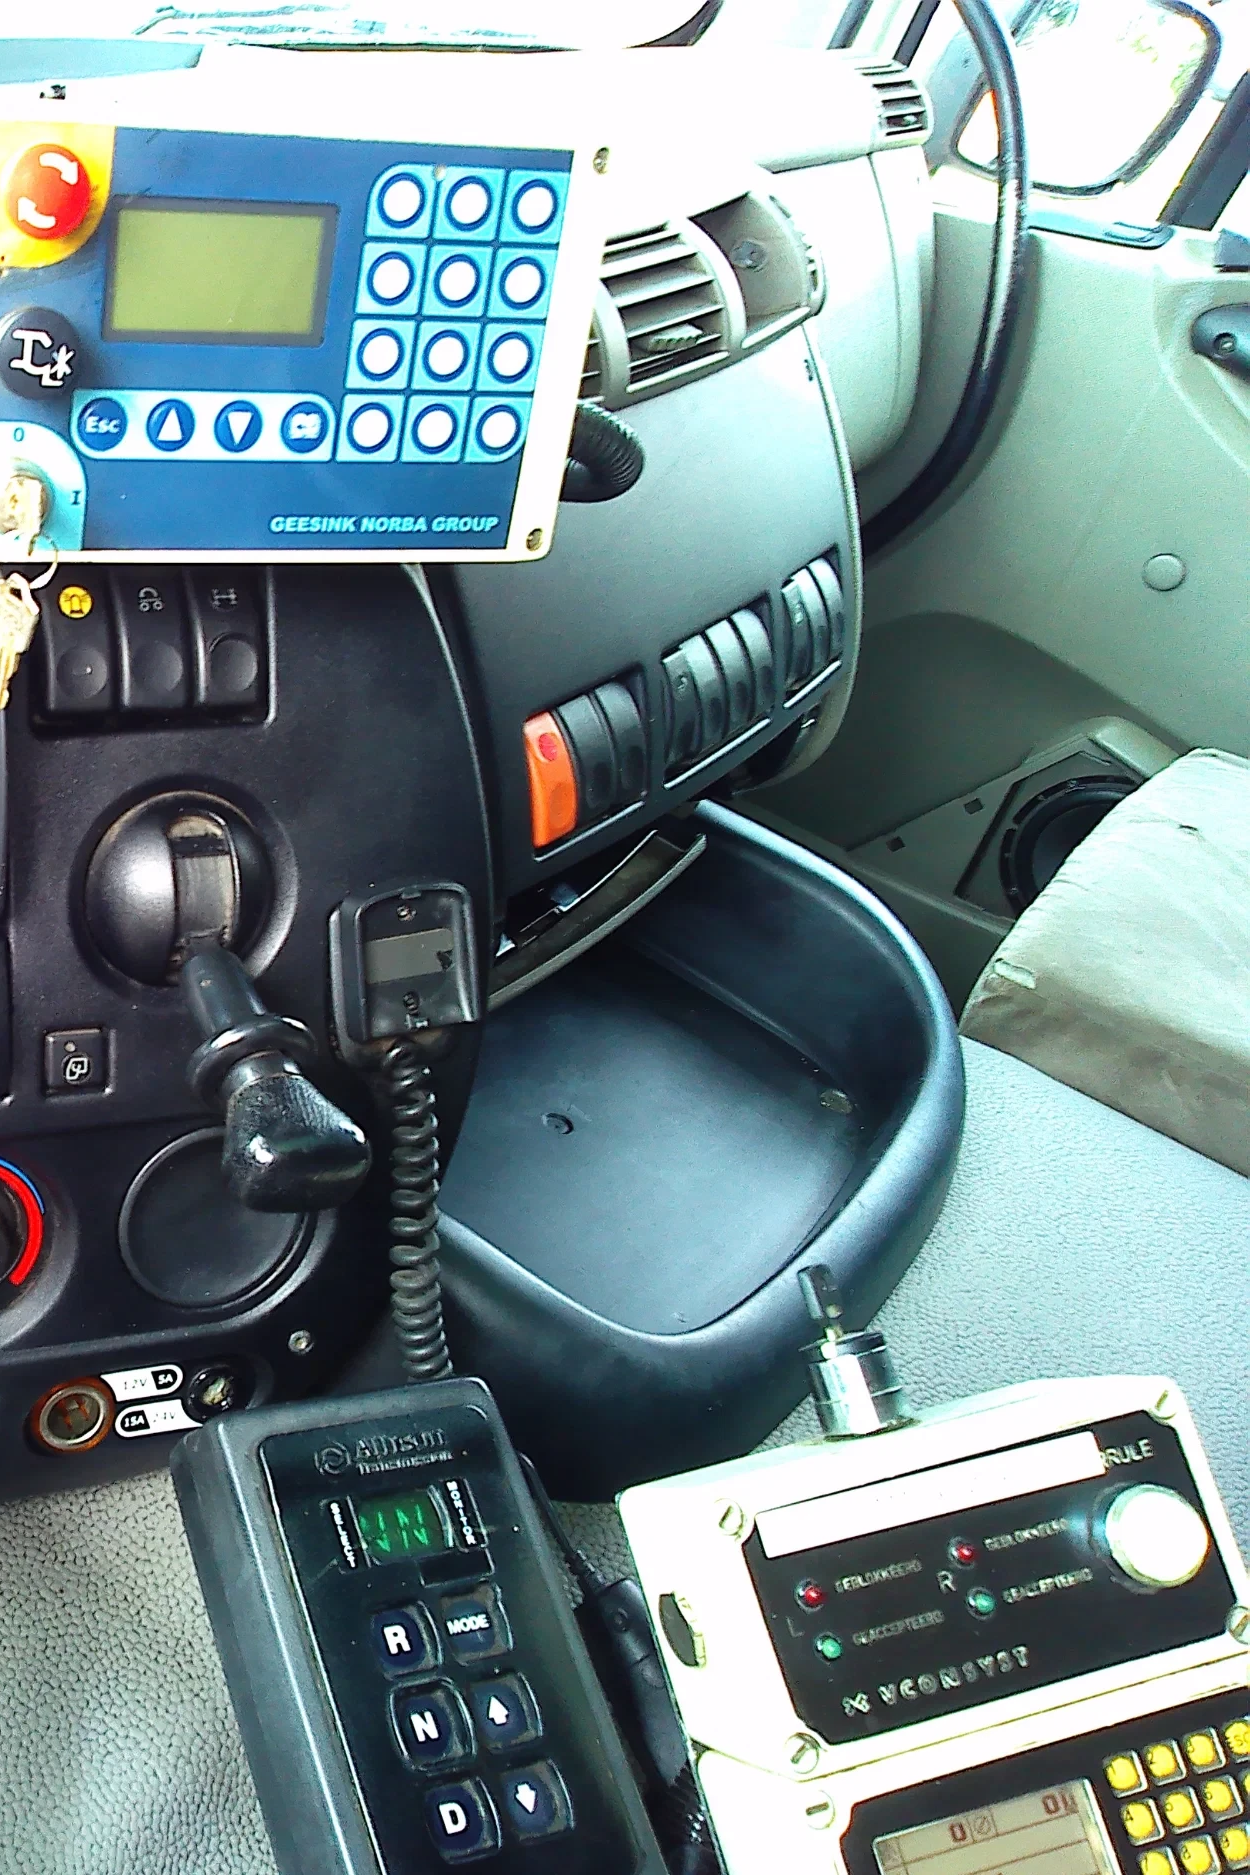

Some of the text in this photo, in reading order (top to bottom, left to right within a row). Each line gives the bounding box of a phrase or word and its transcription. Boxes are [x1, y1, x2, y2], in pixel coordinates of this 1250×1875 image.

[269, 516, 499, 533] GEESINK NORBA GROUP
[446, 1613, 490, 1636] MODE
[383, 1625, 412, 1655] R
[410, 1711, 440, 1742] N
[438, 1803, 468, 1835] D
